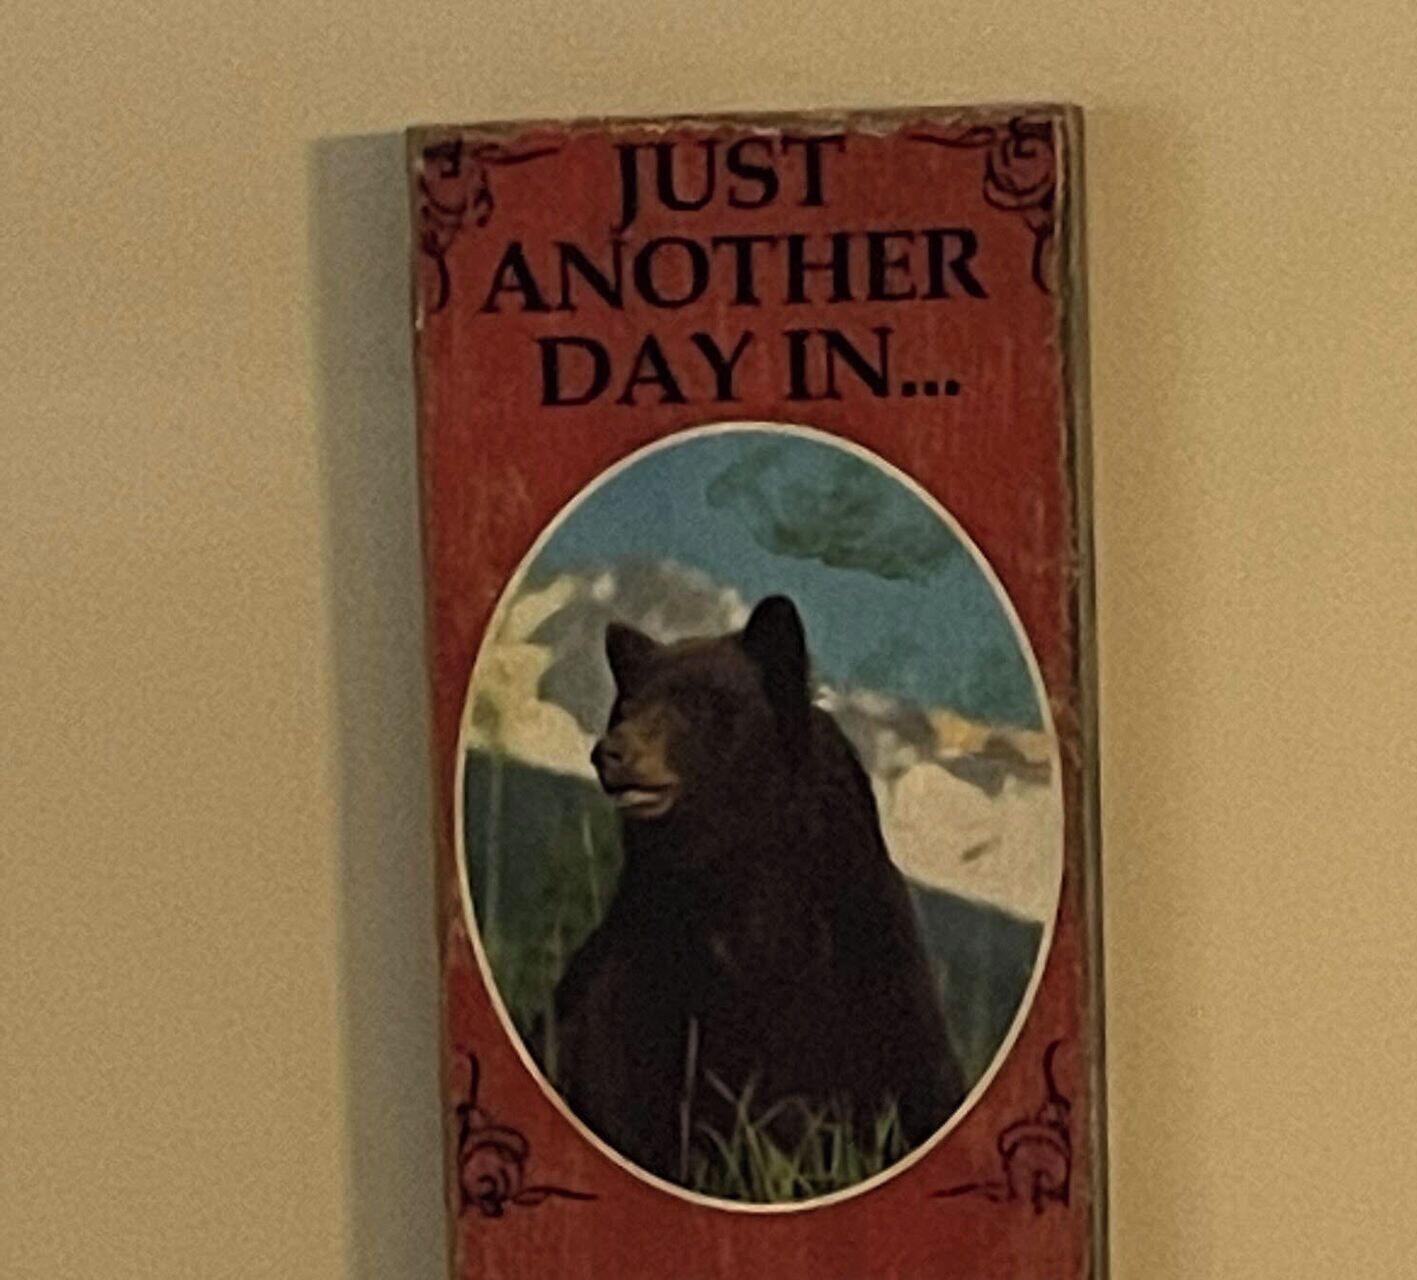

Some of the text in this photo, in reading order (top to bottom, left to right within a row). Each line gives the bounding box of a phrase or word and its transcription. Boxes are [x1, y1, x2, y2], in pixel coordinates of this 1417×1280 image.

[614, 134, 849, 235] JUST
[480, 227, 989, 315] ANOTHER
[537, 325, 962, 408] DAY IN...
